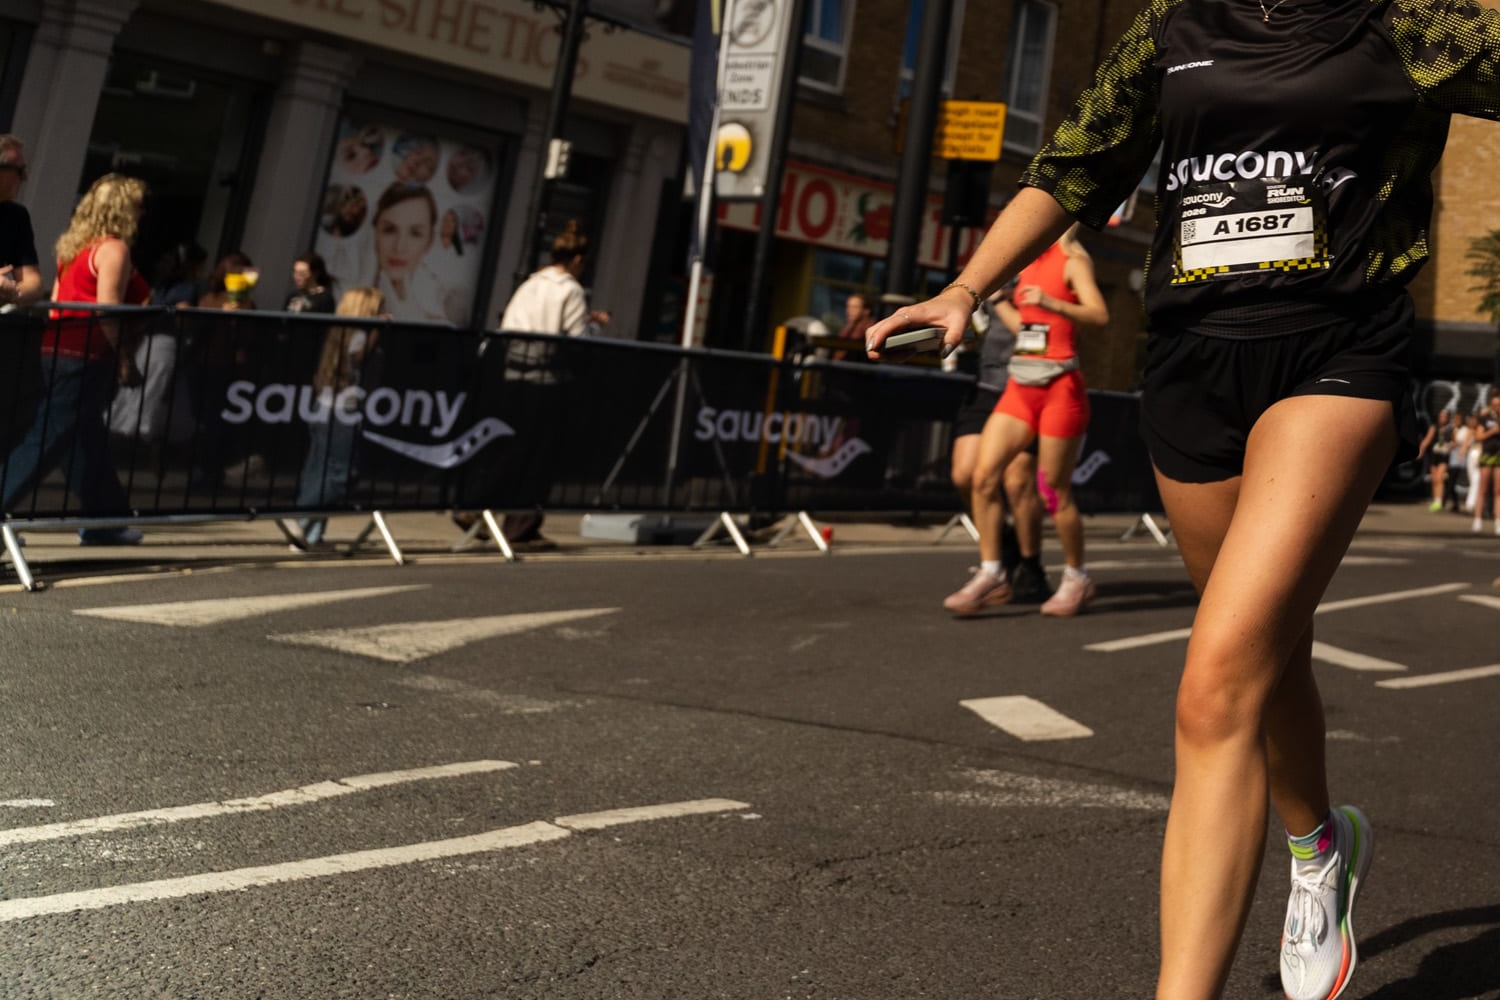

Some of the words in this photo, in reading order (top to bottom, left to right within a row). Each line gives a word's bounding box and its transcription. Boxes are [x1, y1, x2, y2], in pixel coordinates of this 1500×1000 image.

[1182, 191, 1224, 206] saucony
[1266, 187, 1304, 197] RUN
[1213, 220, 1231, 235] A
[1235, 213, 1296, 233] 1687
[221, 380, 468, 438] saucony
[694, 405, 842, 454] saucony
